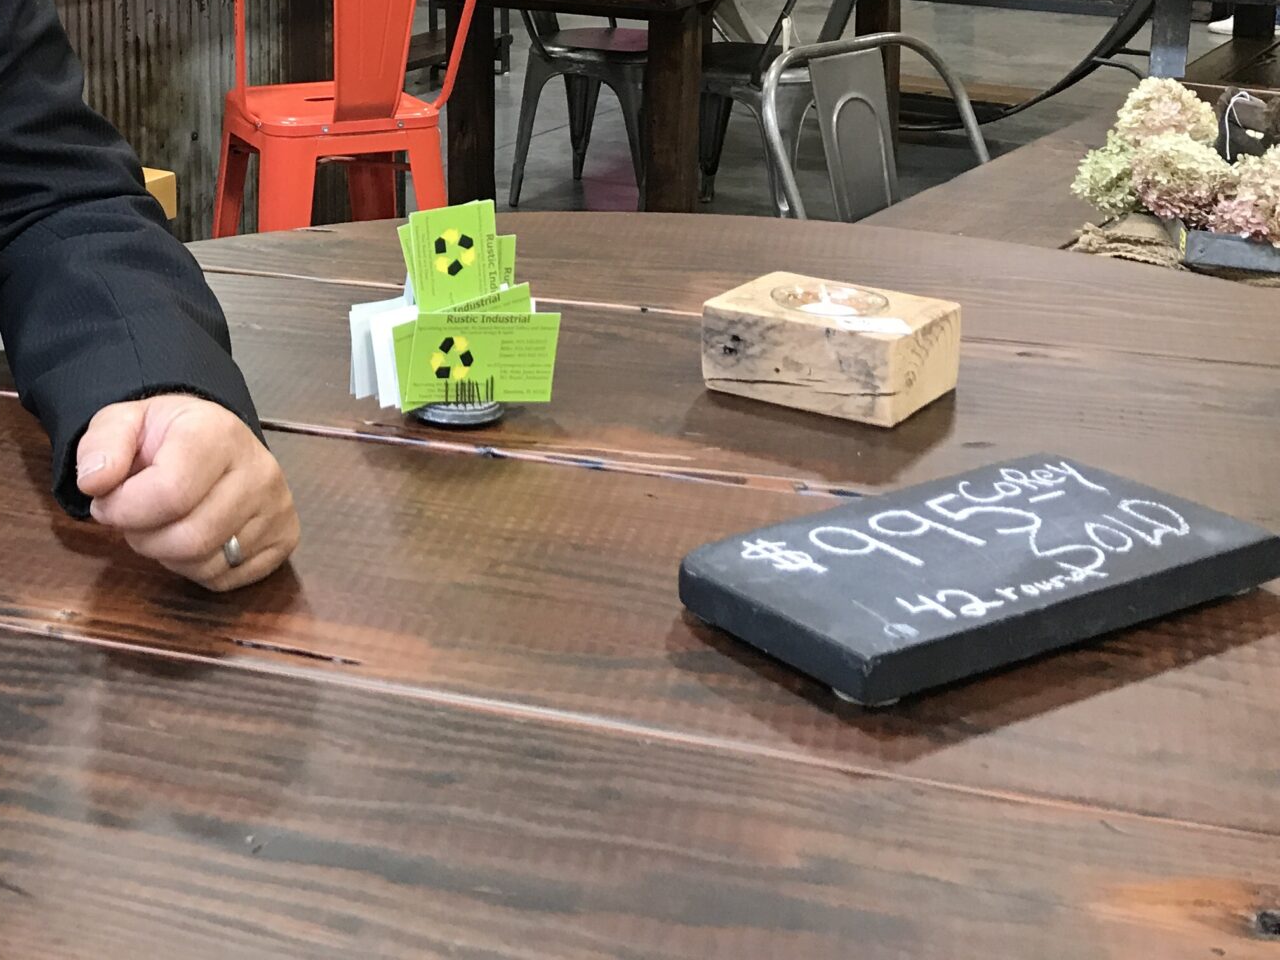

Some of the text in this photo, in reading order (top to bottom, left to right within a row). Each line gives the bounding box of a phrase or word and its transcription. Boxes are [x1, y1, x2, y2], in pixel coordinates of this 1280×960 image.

[453, 293, 501, 312] Industrial
[446, 314, 531, 324] Rustic Industrial
[895, 589, 1005, 619] 42
